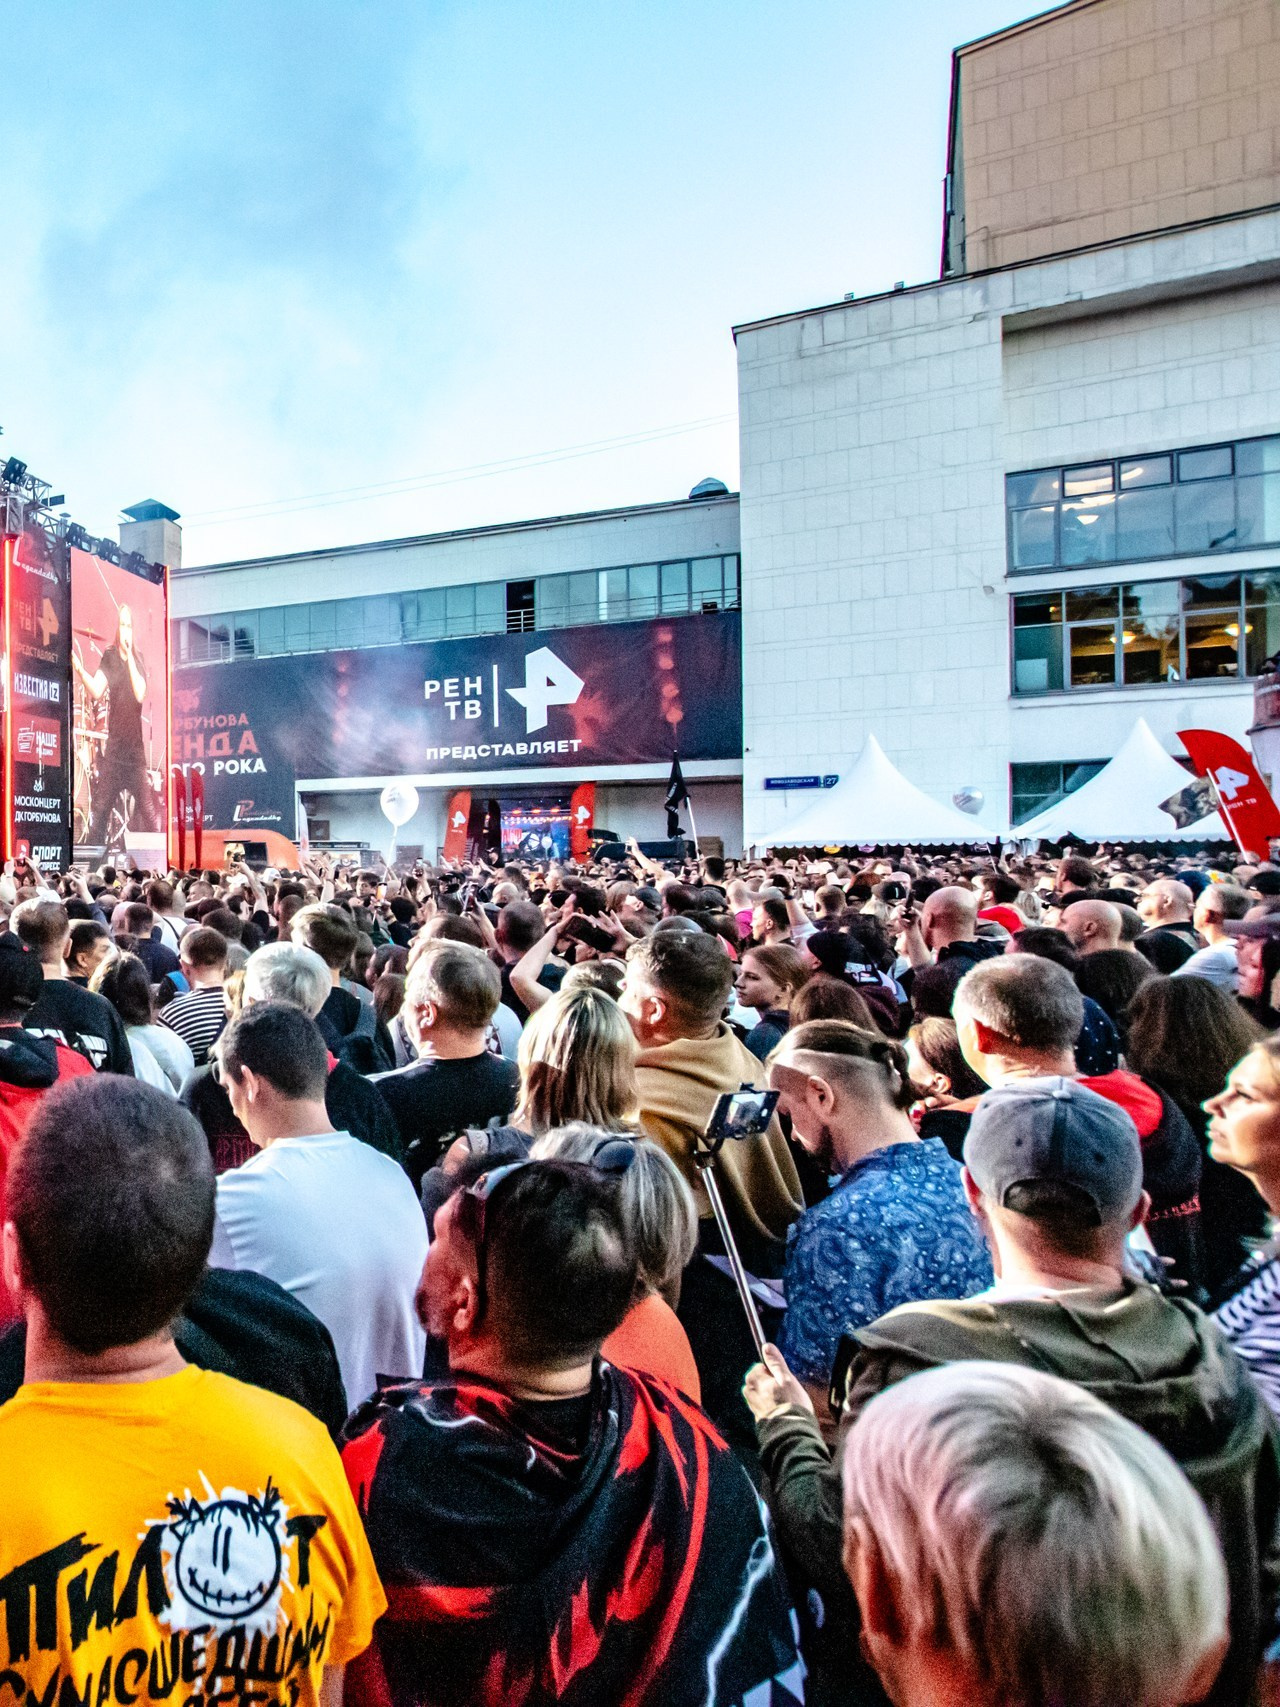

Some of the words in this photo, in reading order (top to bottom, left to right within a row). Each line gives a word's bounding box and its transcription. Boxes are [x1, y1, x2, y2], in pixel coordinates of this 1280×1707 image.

[13, 600, 32, 617] РЕН
[19, 616, 31, 631] ТВ
[14, 672, 48, 700] ИЗВЕСТИЯ
[424, 676, 482, 699] РЕН
[444, 700, 482, 720] ТВ
[173, 712, 249, 731] РБУНОВА
[36, 731, 57, 748] НАШЕ
[172, 730, 259, 759] ЕНДА
[426, 739, 582, 760] ПРЕДСТАВЛЯЕТ
[214, 757, 267, 777] РОКА
[826, 777, 837, 785] 27
[14, 795, 61, 809] МОСКОНЦЕРТ
[14, 811, 24, 823] ДК
[24, 811, 61, 823] ГОРБУНОВА
[32, 846, 62, 860] СПОРТ
